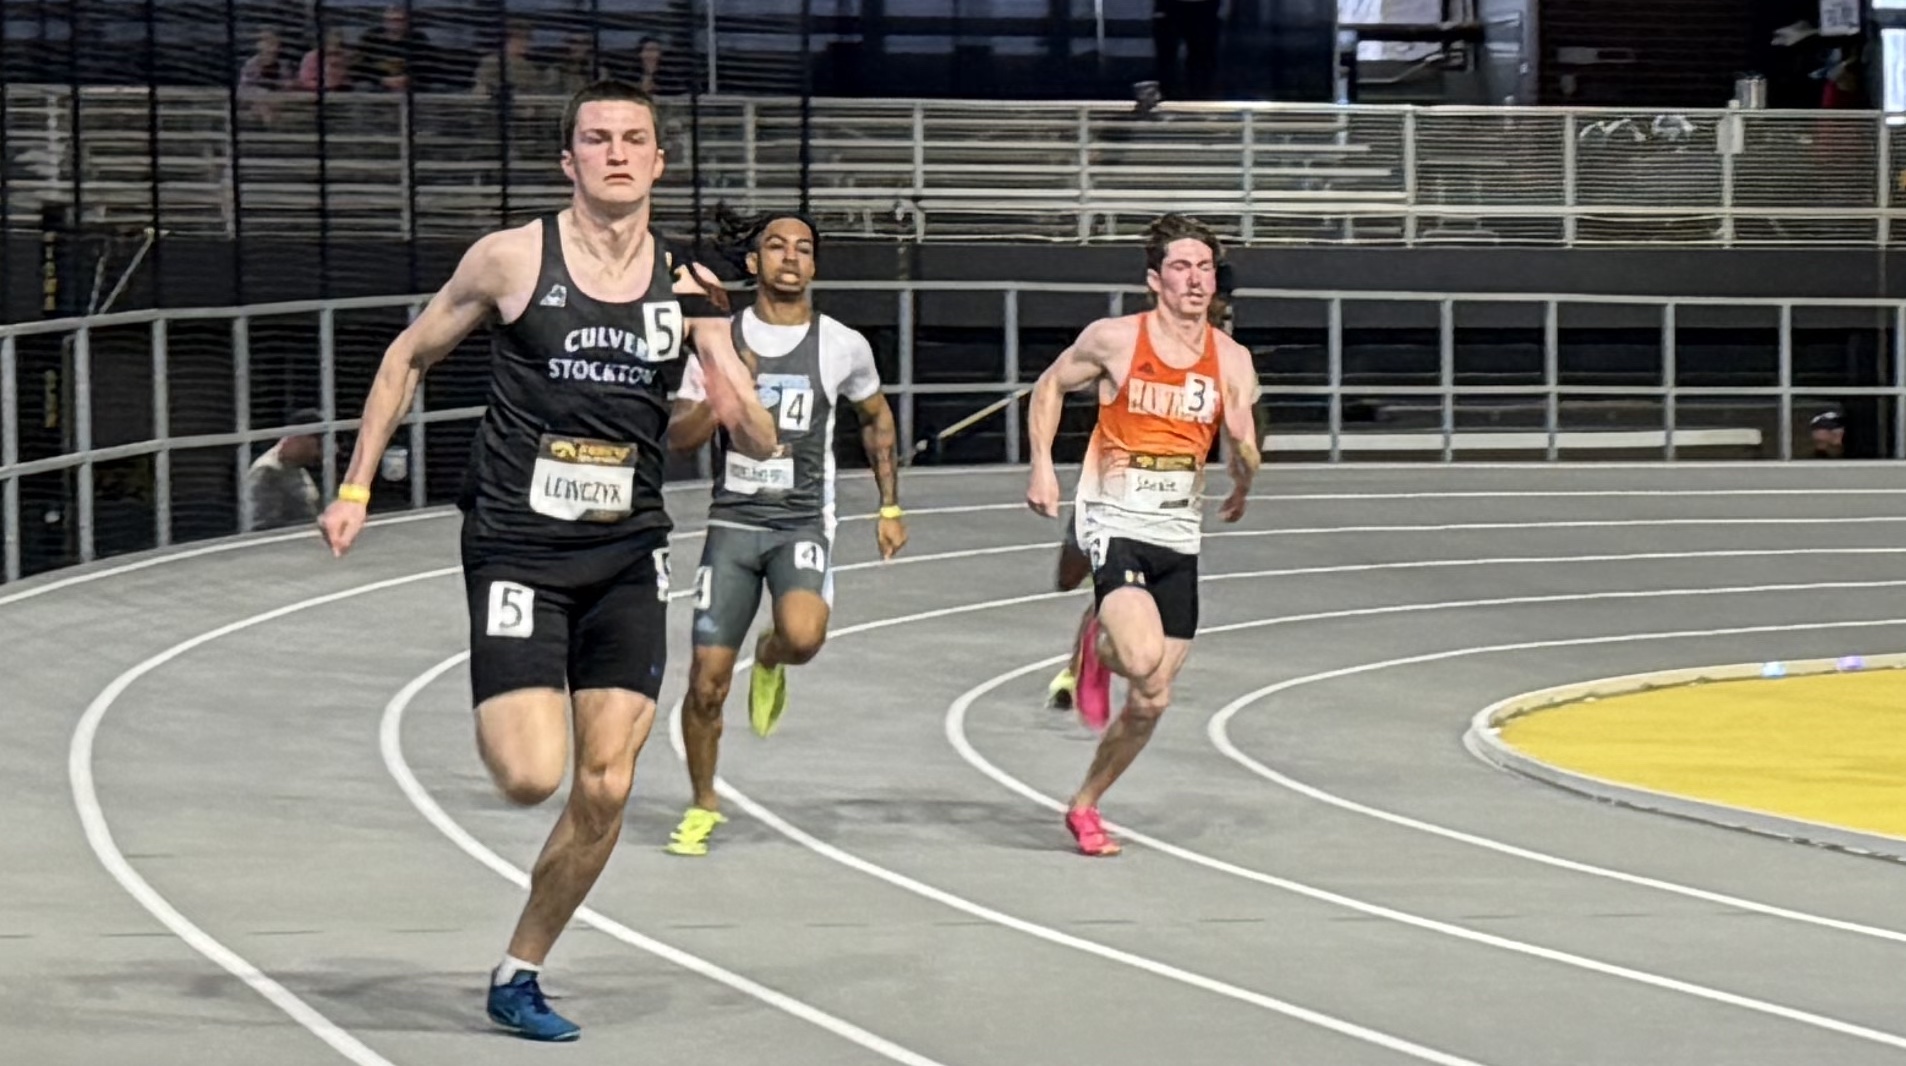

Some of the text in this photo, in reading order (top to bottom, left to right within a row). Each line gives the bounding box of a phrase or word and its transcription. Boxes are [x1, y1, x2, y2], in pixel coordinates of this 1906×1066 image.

[654, 306, 674, 357] 5
[786, 392, 805, 426] 4
[1188, 378, 1206, 412] 3
[499, 587, 523, 628] 5
